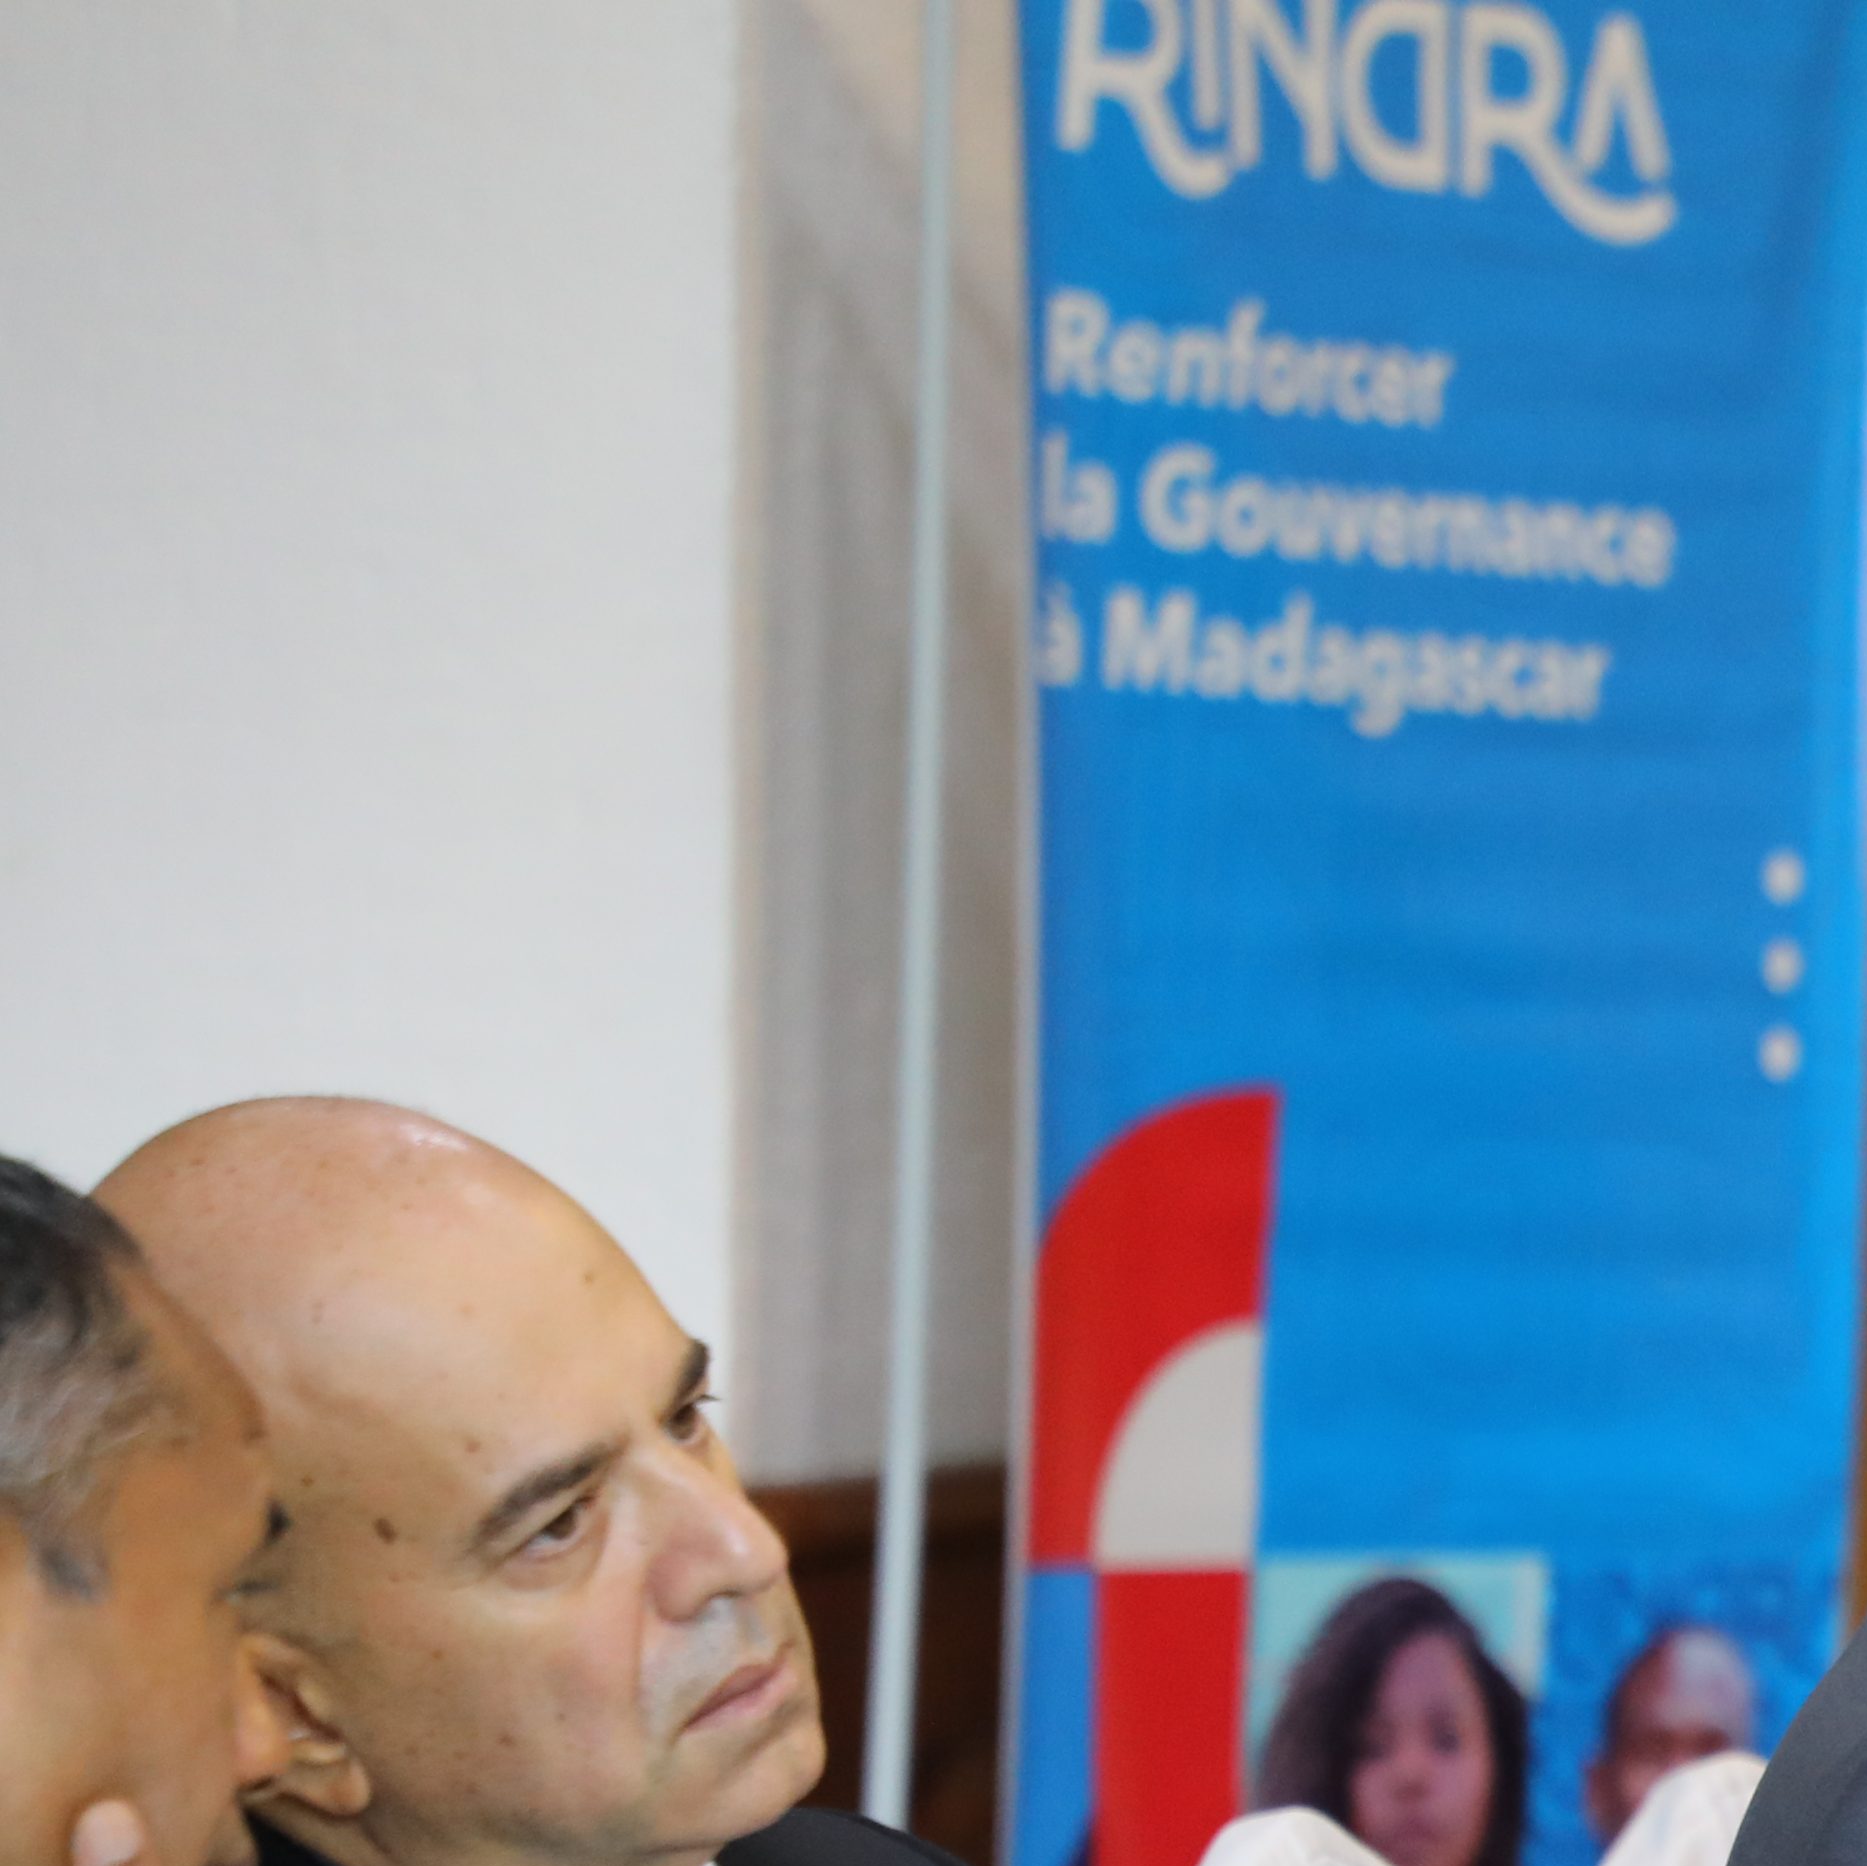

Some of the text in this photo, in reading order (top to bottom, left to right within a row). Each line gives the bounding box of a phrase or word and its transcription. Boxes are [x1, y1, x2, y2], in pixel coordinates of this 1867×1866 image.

[1057, 0, 1678, 244] RINDRA
[1045, 289, 1454, 427] Renforcer
[1042, 430, 1676, 587] la Gouvernance
[1103, 586, 1607, 738] Madagascar
